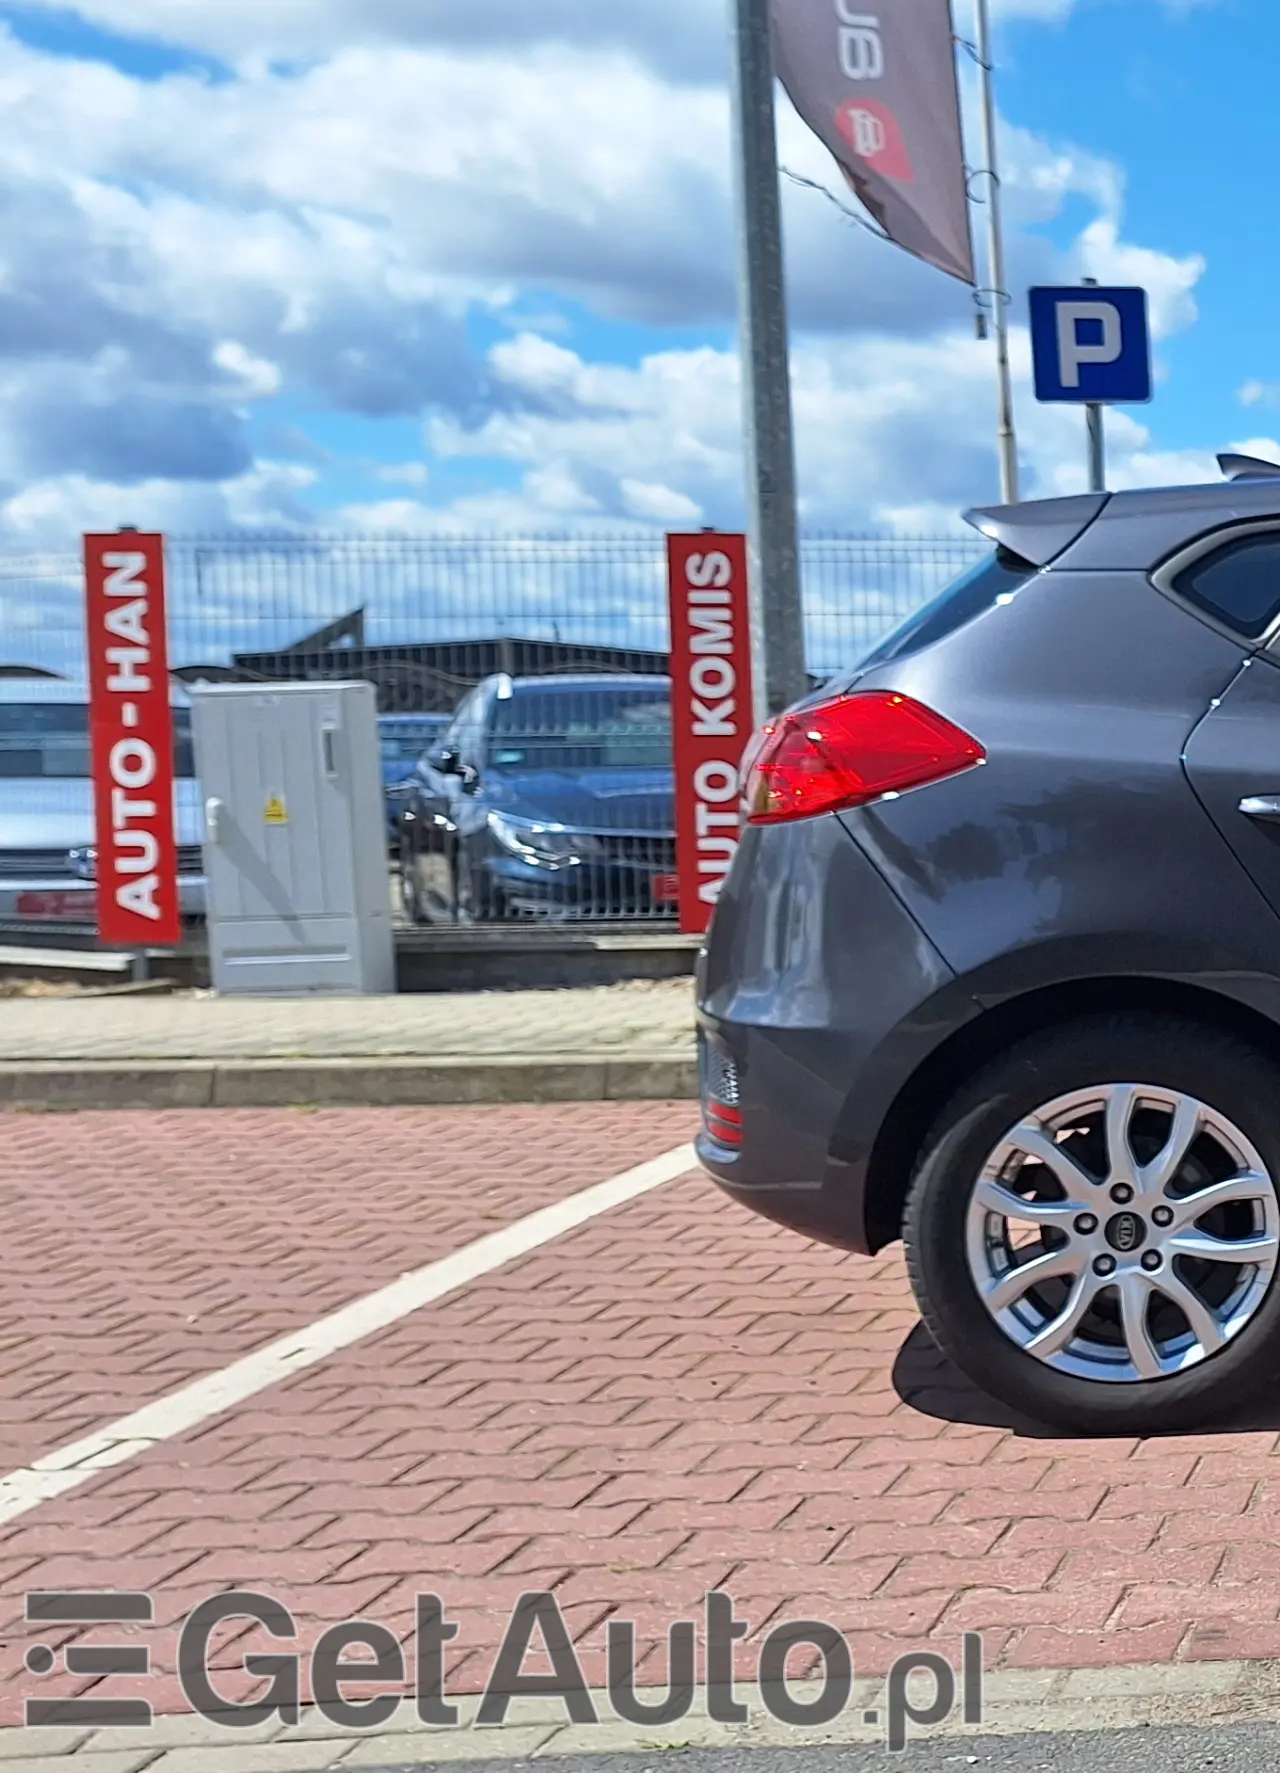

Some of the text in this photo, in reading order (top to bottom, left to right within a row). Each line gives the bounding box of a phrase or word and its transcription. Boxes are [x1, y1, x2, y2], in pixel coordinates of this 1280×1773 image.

[1055, 301, 1122, 387] P
[102, 551, 161, 920] AUTO-HAN
[685, 551, 738, 736] KOMIS
